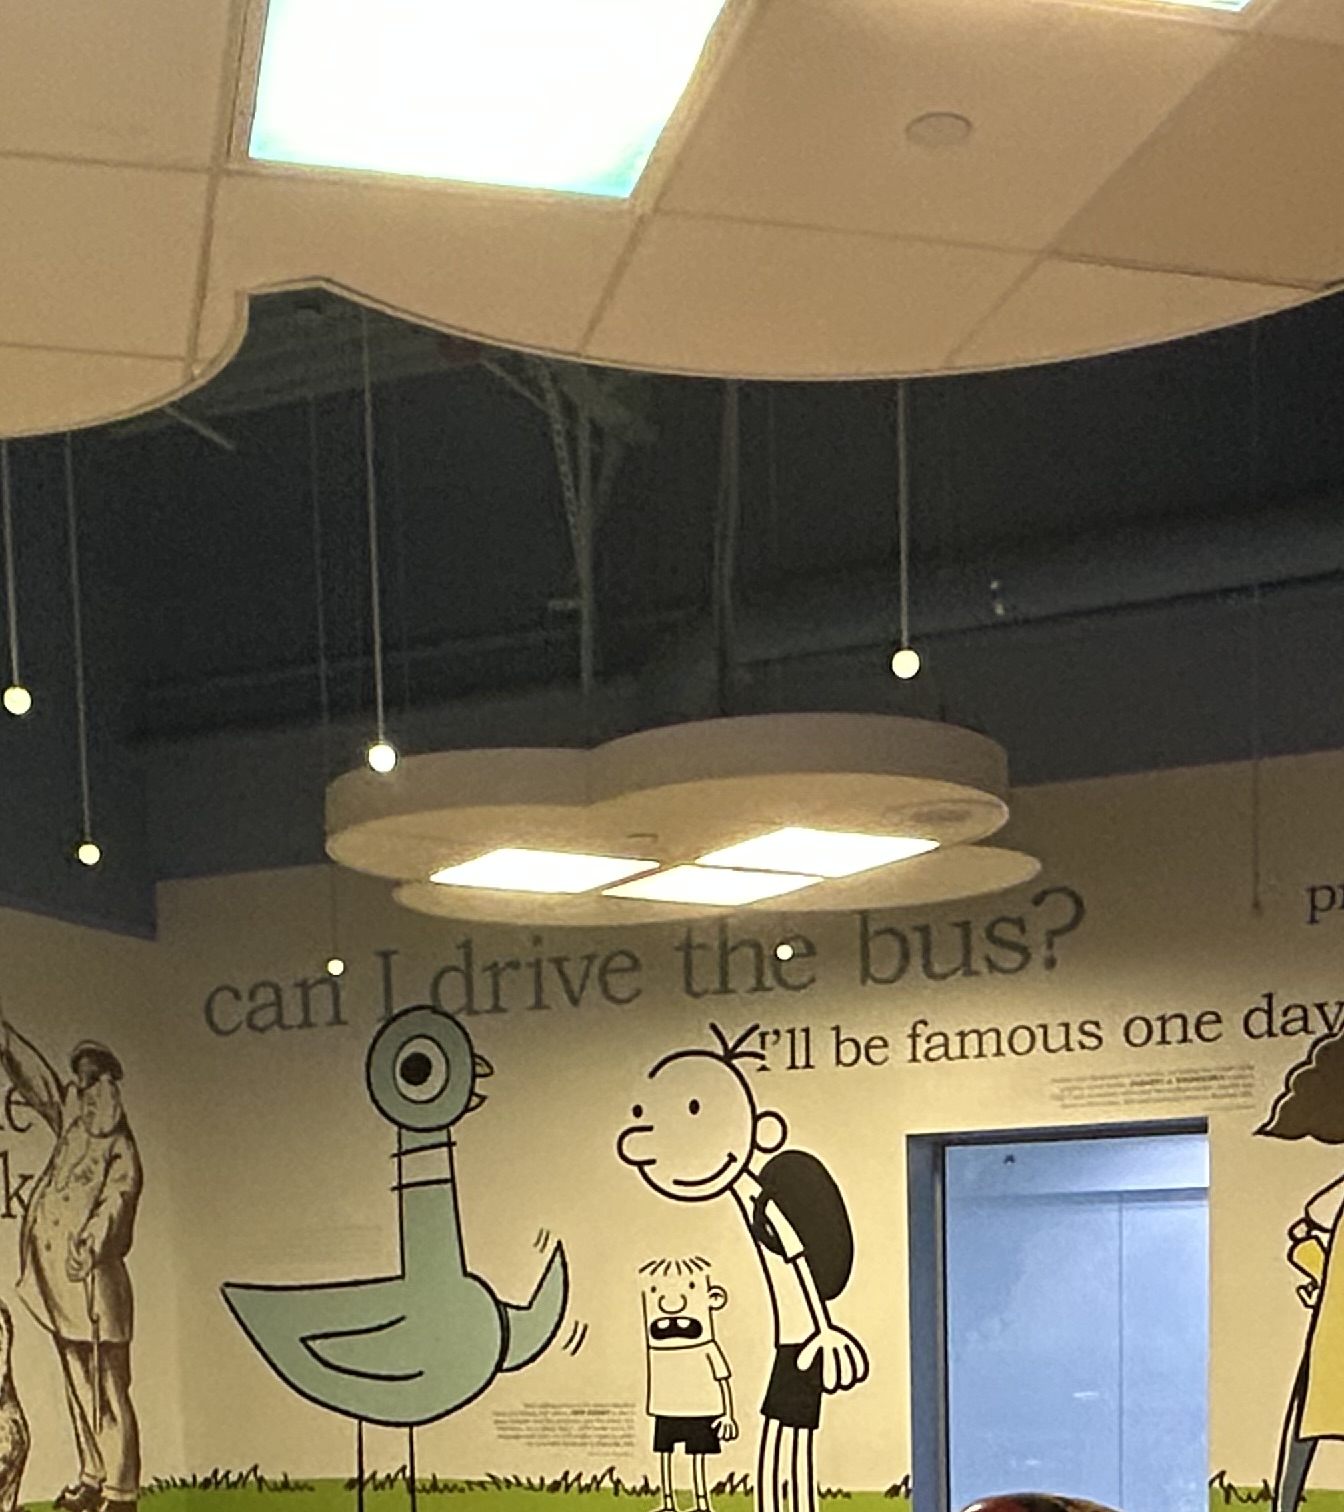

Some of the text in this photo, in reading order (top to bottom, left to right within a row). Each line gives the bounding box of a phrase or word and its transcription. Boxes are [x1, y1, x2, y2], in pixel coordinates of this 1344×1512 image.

[204, 886, 1085, 1036] can I drive the bus?
[830, 1024, 890, 1068] be
[907, 1020, 1103, 1064] famous
[1122, 1007, 1223, 1049] one
